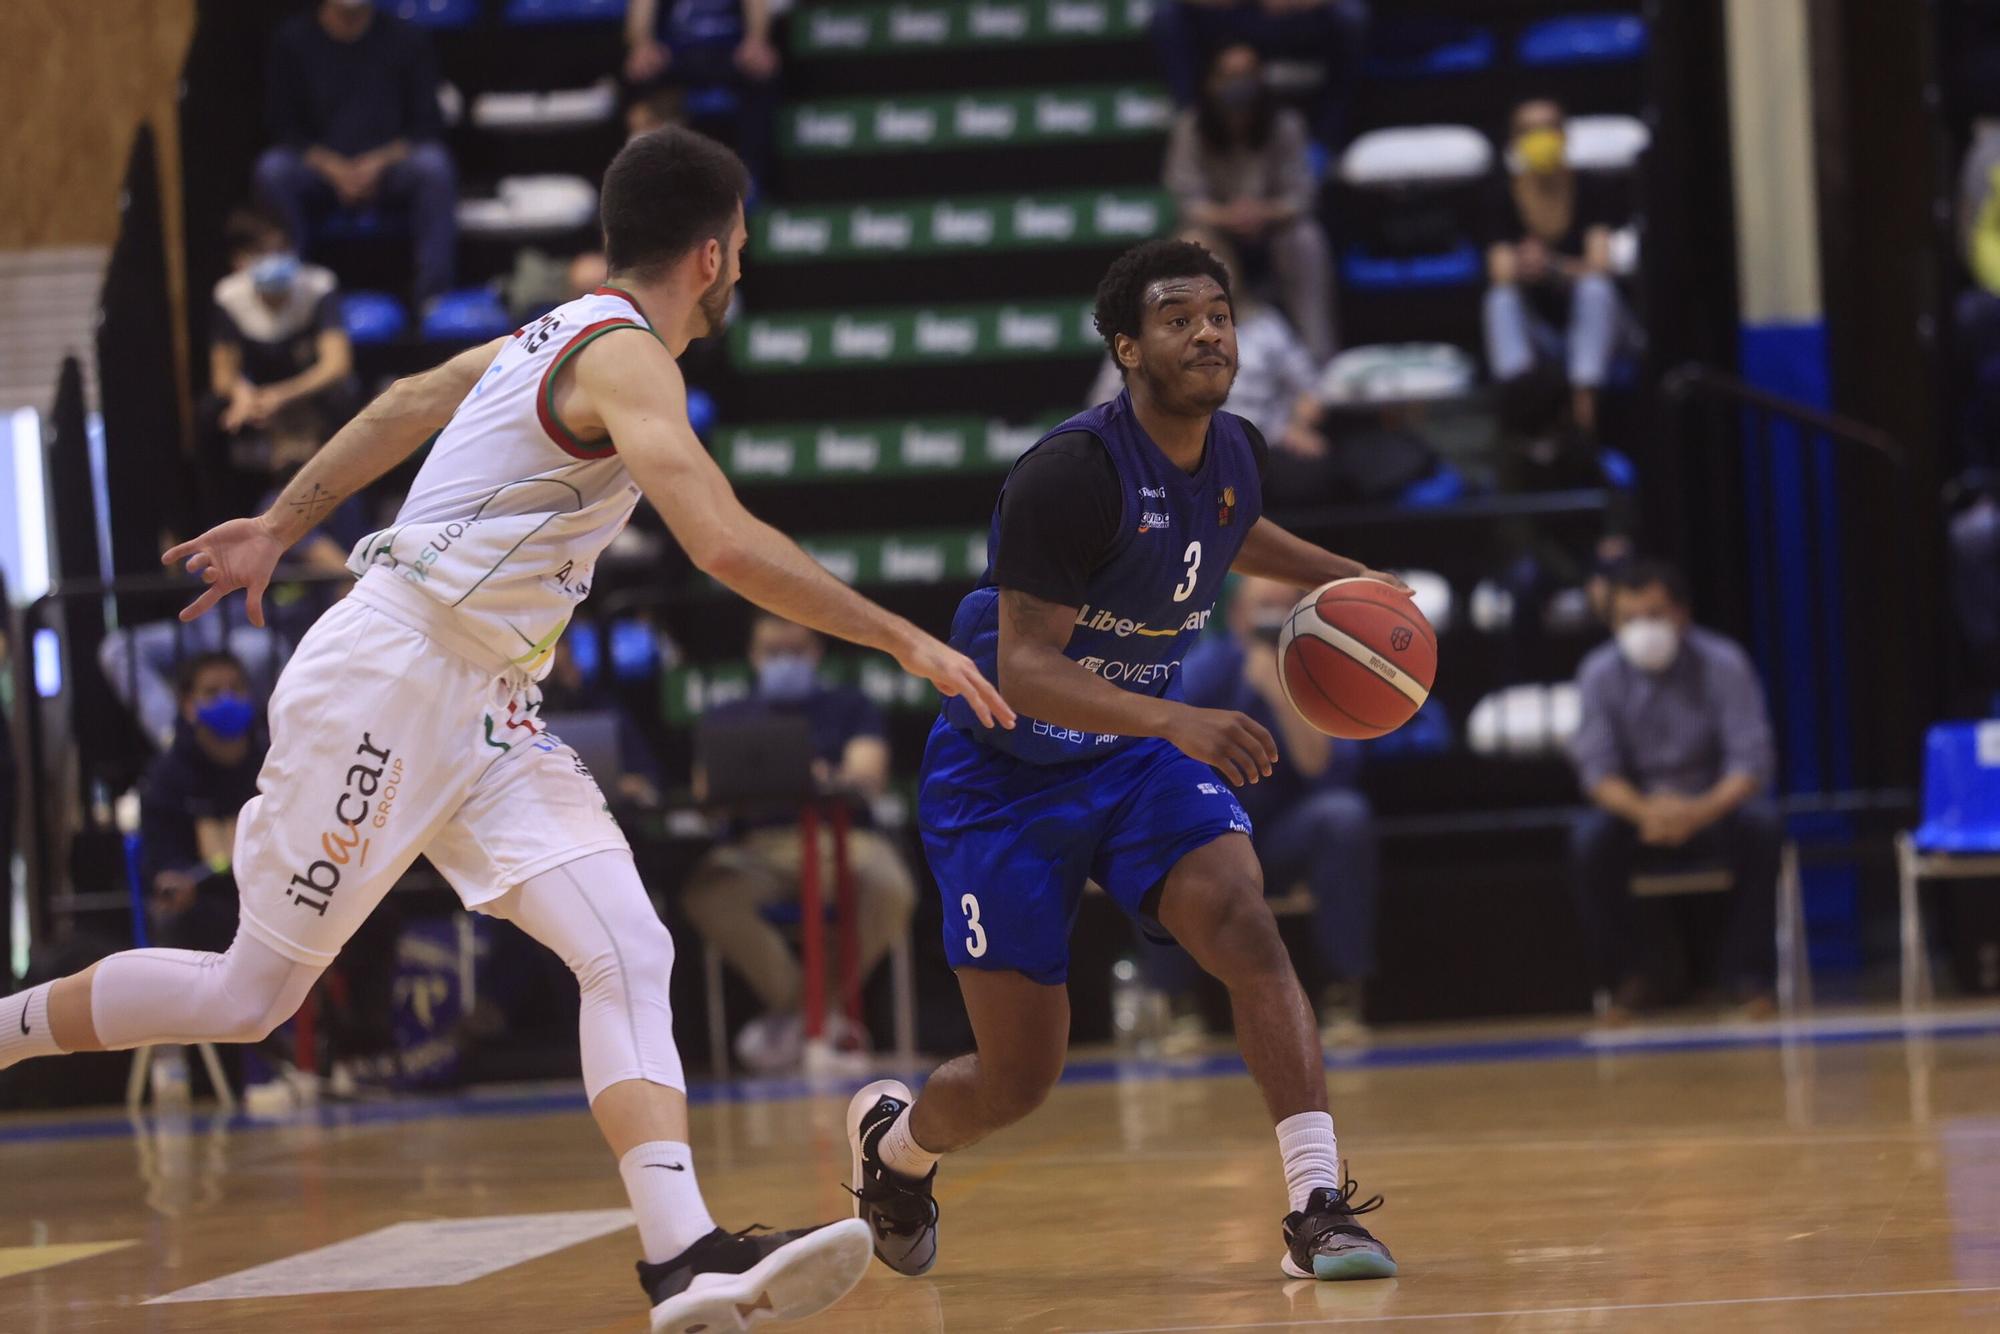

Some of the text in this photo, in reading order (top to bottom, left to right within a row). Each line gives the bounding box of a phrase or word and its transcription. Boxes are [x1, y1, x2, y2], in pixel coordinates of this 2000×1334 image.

[1173, 541, 1202, 602] 3
[286, 732, 391, 917] ibacar
[371, 757, 404, 829] GROUP
[961, 892, 988, 959] 3
